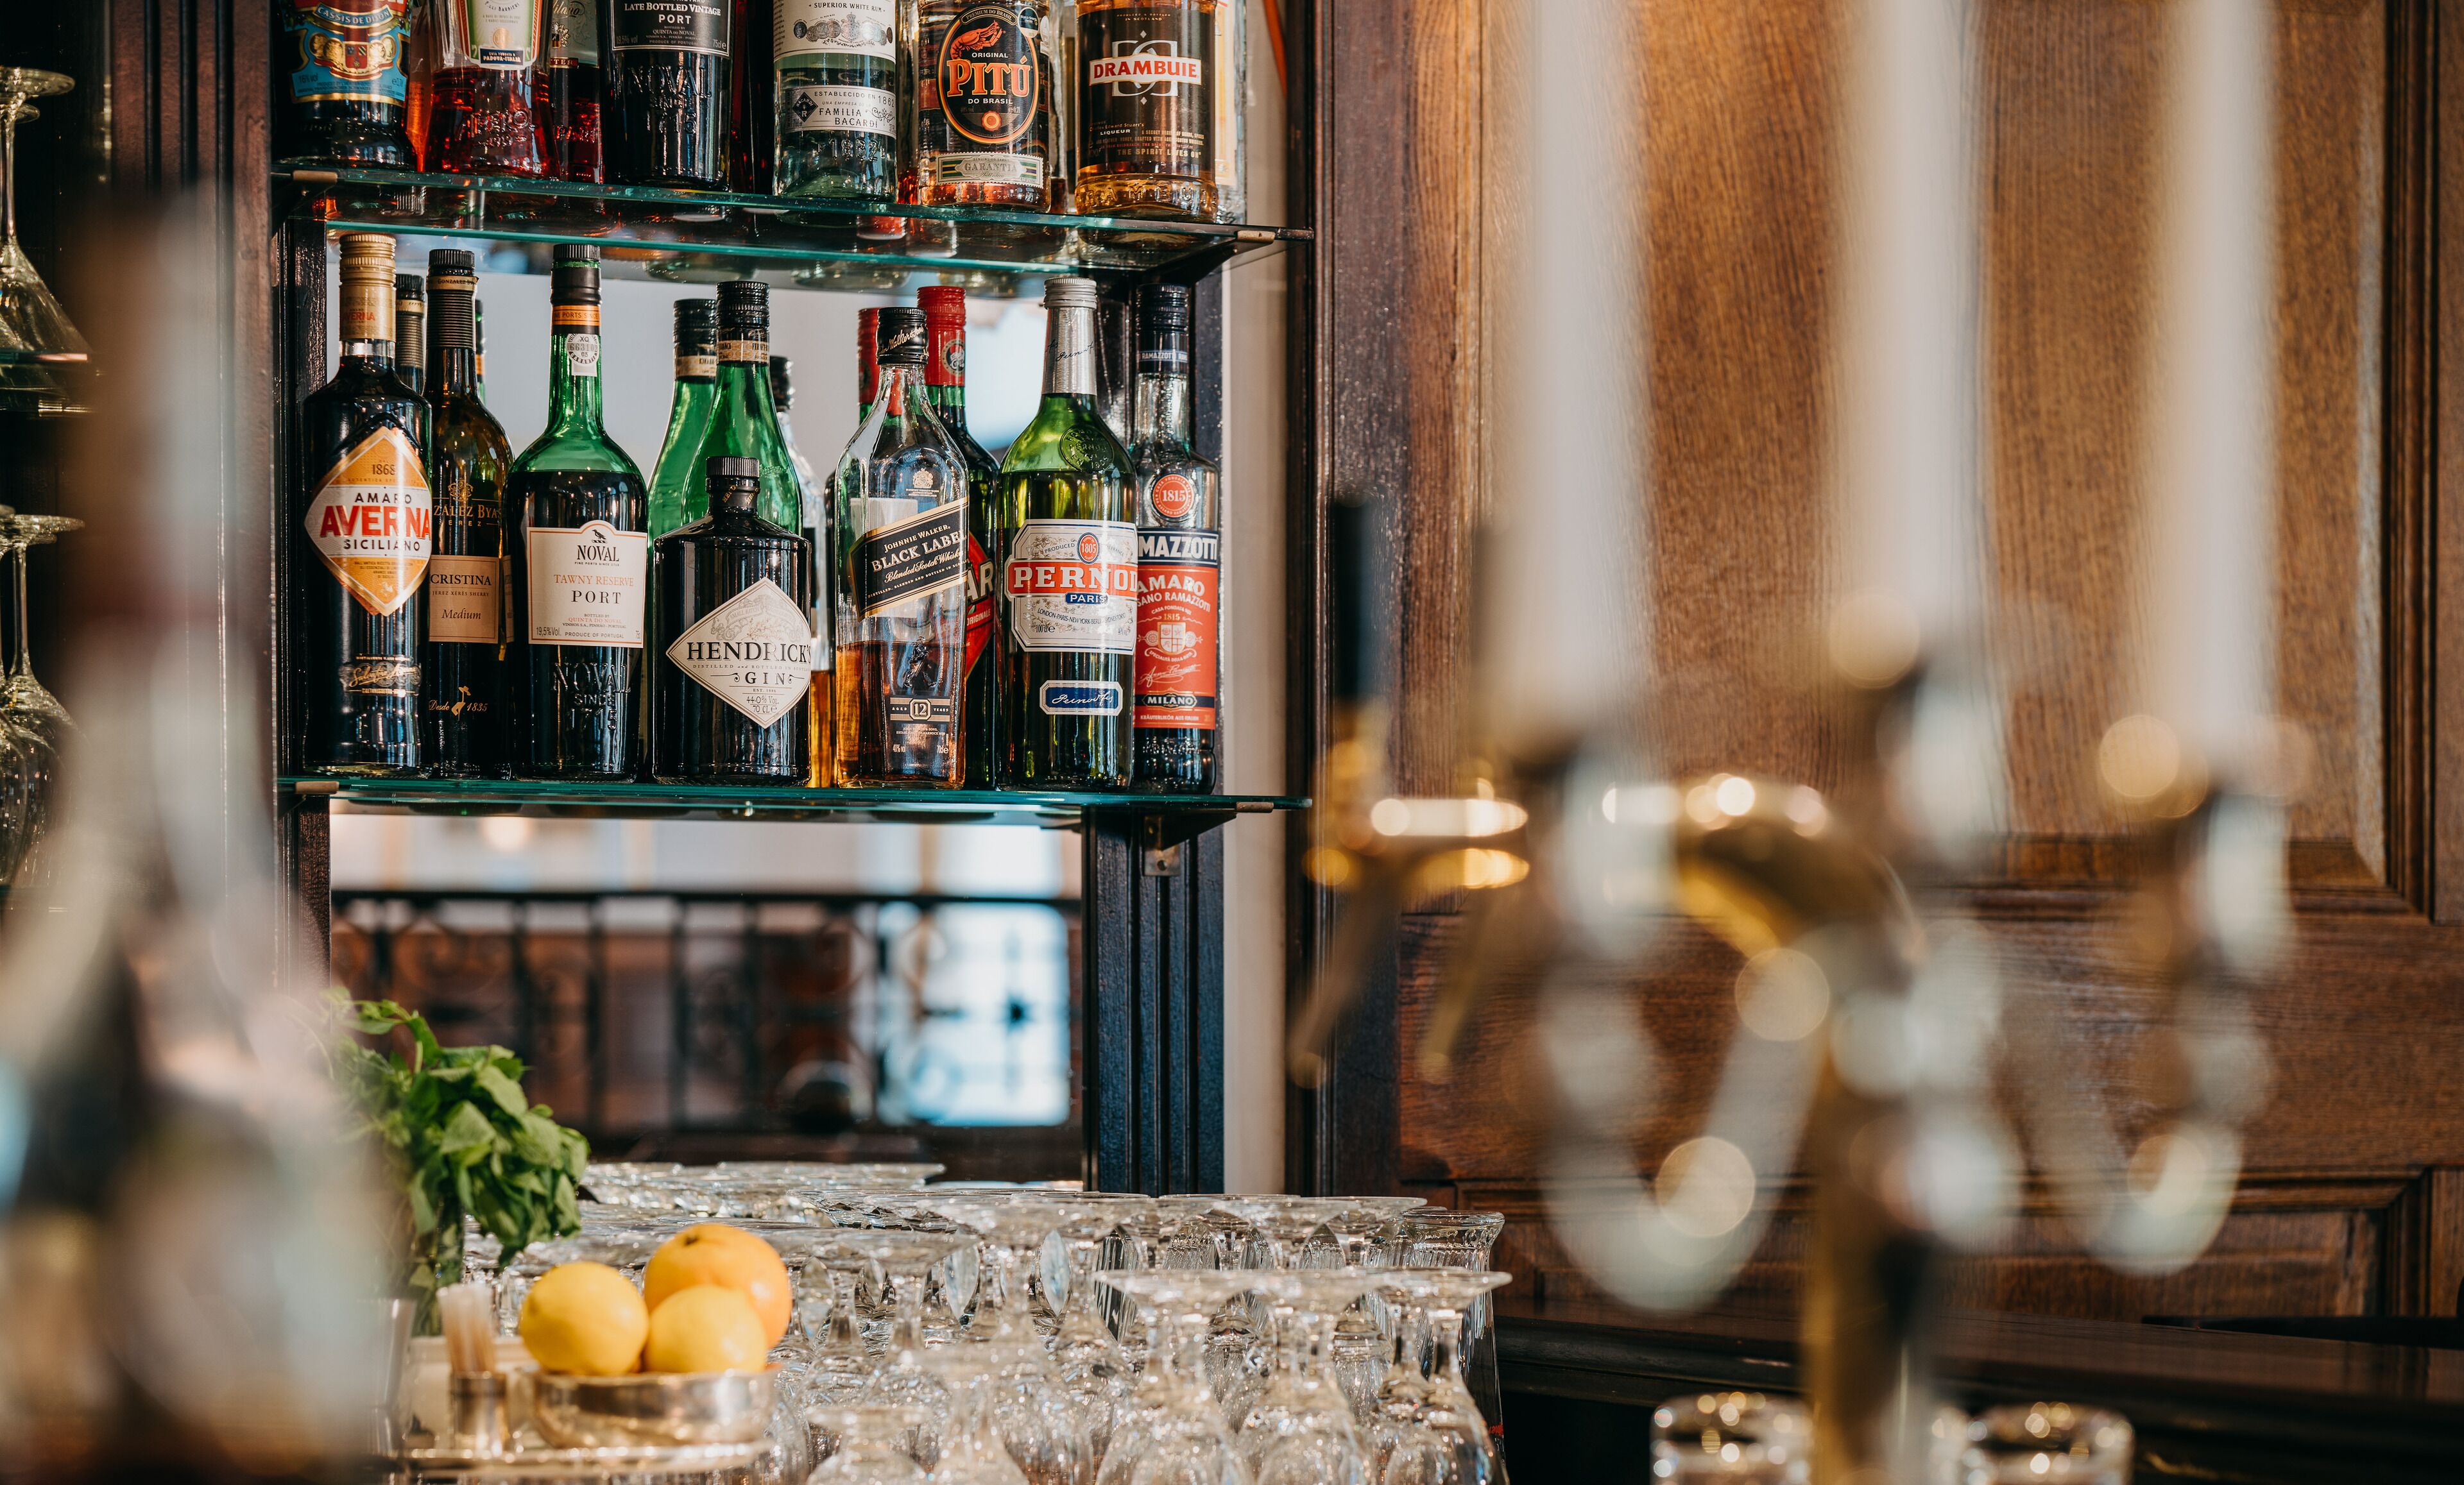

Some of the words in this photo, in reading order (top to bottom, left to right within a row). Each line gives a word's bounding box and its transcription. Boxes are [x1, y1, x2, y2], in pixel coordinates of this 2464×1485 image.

[553, 0, 580, 15] ilano
[646, 2, 689, 12] BOTTLED
[689, 4, 721, 16] VINTAGE
[318, 6, 352, 24] CASSIS
[658, 14, 692, 24] PORT
[966, 9, 988, 20] PREMIUM
[996, 10, 1013, 21] BRASIL
[946, 55, 1031, 97] PITÚ
[1093, 60, 1197, 79] DRAMBUIE
[878, 96, 895, 108] 1862
[819, 108, 862, 117] FAMILIA
[1167, 149, 1188, 157] LVES
[964, 162, 1017, 172] GARANTIA
[372, 463, 396, 475] 1868
[1161, 489, 1186, 502] 1815
[434, 504, 474, 517] ZÁLEZ
[320, 504, 432, 541] AVERNA
[343, 539, 420, 552] SICILIANO
[870, 545, 921, 573] BLACK
[921, 529, 968, 555] LABEL
[884, 535, 918, 554] JOHNNIE
[1044, 543, 1075, 554] PRODUCED
[1081, 543, 1097, 554] 1805
[1138, 535, 1217, 561] MAZZOTTI
[576, 545, 620, 562] NOVAL
[884, 563, 916, 584] Blended
[915, 556, 937, 572] Scotch
[431, 573, 492, 586] CRISTINA
[554, 574, 593, 584] TAWNY
[595, 576, 635, 587] RESERVE
[894, 579, 914, 590] BLENDED
[925, 568, 945, 577] BOTTLED
[1013, 566, 1138, 593] PERNOD
[1138, 574, 1206, 597] AMARO
[571, 590, 621, 604] PORT
[1070, 594, 1108, 603] PARIS
[1137, 593, 1163, 607] SANO
[1165, 591, 1211, 613] RAMAZZOTTI
[441, 607, 482, 620] Medium
[1151, 606, 1164, 615] CASA
[1163, 613, 1181, 621] 1815
[744, 671, 785, 685] GIN
[429, 699, 449, 711] Desde
[466, 702, 488, 712] 1835
[1147, 696, 1194, 705] MILANO
[752, 704, 761, 713] 70
[914, 703, 928, 717] 12
